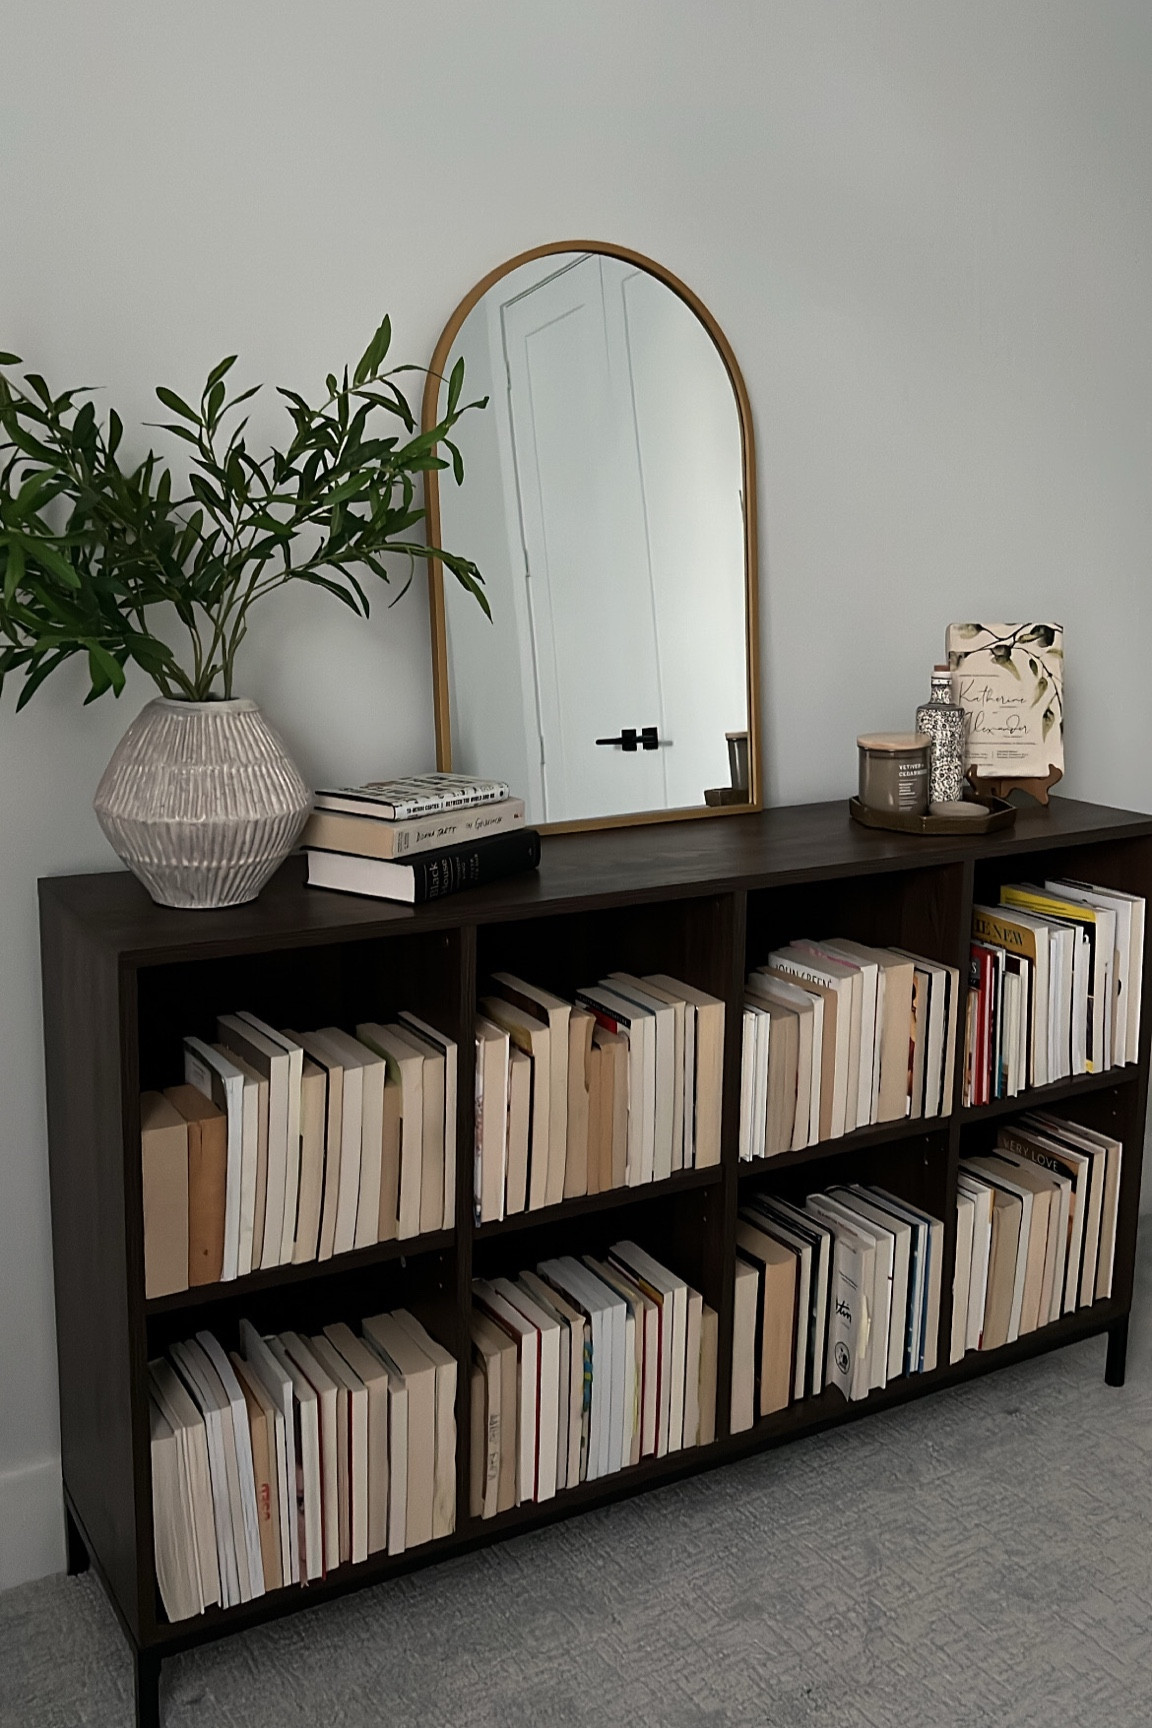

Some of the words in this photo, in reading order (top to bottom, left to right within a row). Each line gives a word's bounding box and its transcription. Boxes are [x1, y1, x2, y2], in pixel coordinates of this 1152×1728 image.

[958, 679, 1027, 707] Katherine
[428, 861, 440, 898] Black
[440, 858, 449, 896] House
[1031, 1151, 1059, 1173] LOVE
